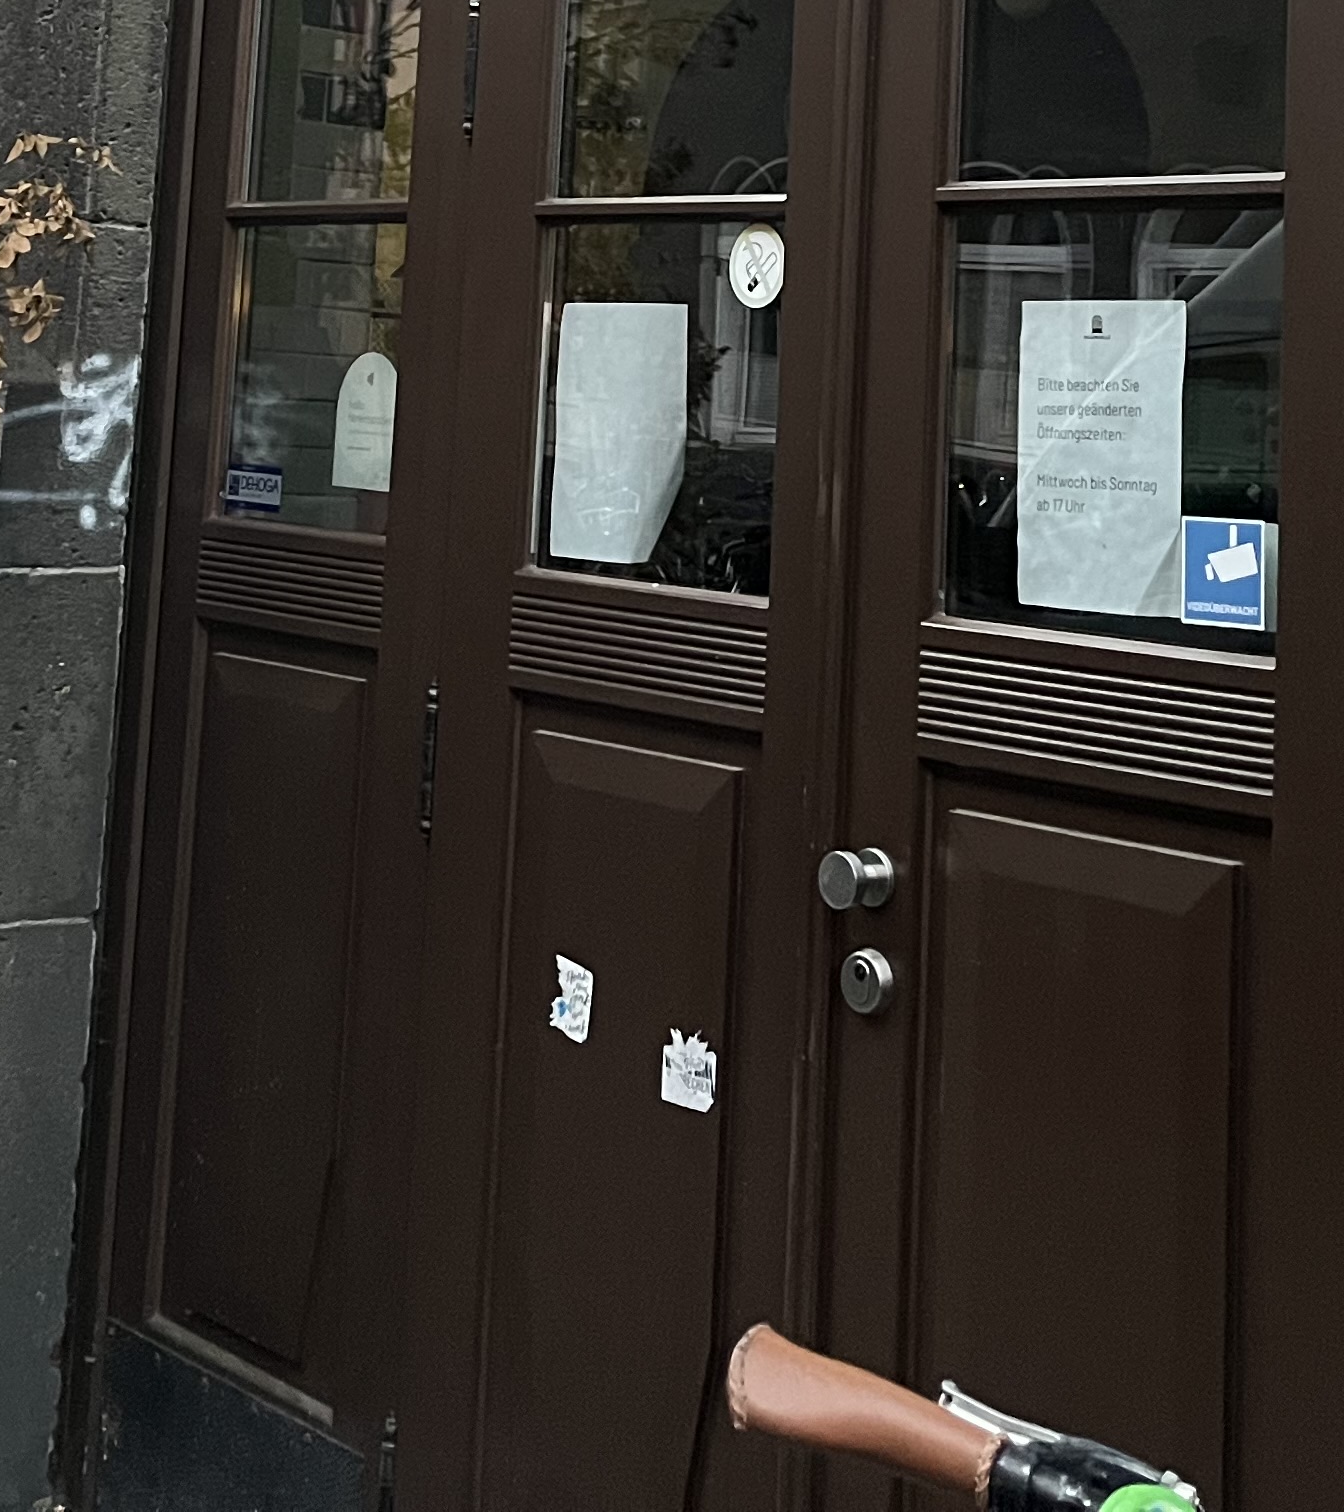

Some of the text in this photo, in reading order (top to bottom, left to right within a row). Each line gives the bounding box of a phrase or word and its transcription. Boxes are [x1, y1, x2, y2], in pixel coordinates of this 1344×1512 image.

[1037, 377, 1140, 393] Bitte beachten Sie
[1037, 402, 1142, 419] unsere geänderten
[1036, 474, 1158, 496] Mittwoch bis Sonntag
[1036, 498, 1086, 513] ab 17 Uhr
